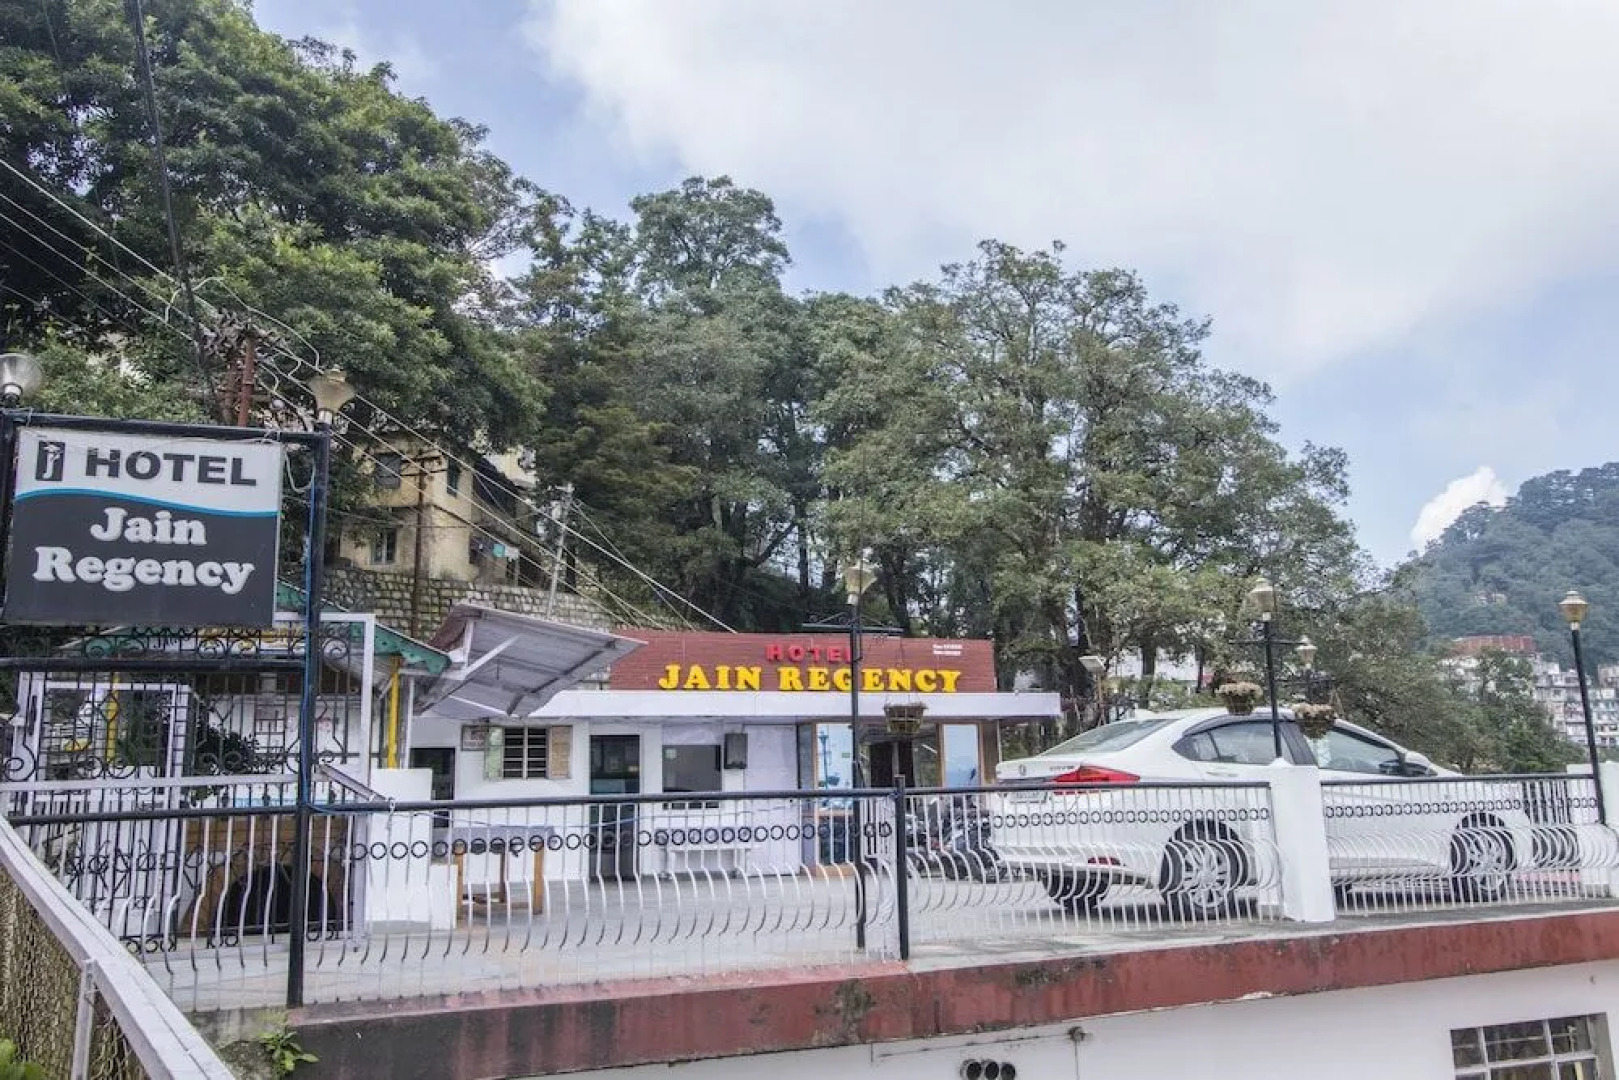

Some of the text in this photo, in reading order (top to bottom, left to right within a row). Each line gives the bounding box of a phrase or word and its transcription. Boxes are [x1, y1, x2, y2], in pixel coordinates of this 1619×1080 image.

[85, 447, 257, 487] HOTEL
[90, 507, 208, 546] Jain
[32, 546, 255, 595] Regency
[658, 662, 961, 693] JAIN REGENCY
